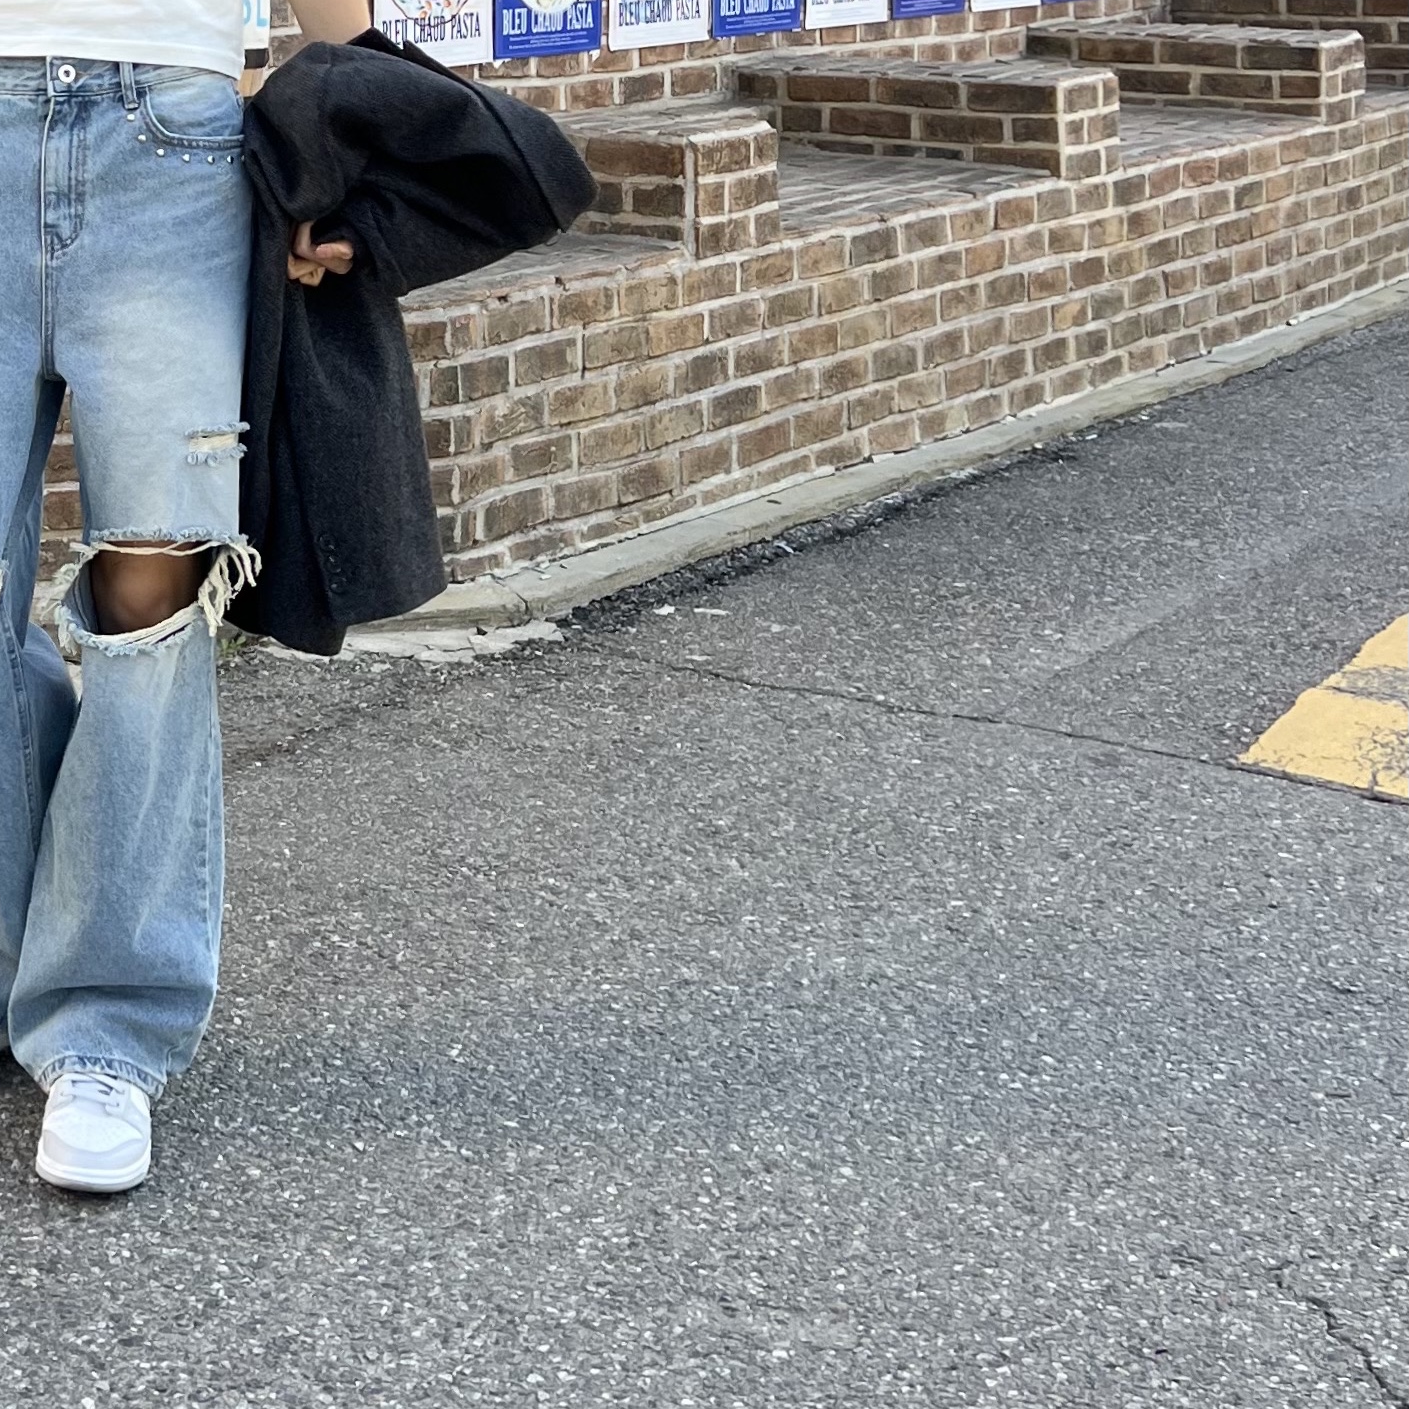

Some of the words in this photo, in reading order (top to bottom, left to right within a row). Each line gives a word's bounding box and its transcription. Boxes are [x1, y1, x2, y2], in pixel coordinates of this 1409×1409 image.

[450, 11, 481, 40] PASTA
[502, 7, 528, 36] BLEU
[567, 2, 594, 30] PASTA
[618, 0, 640, 27] BLEU
